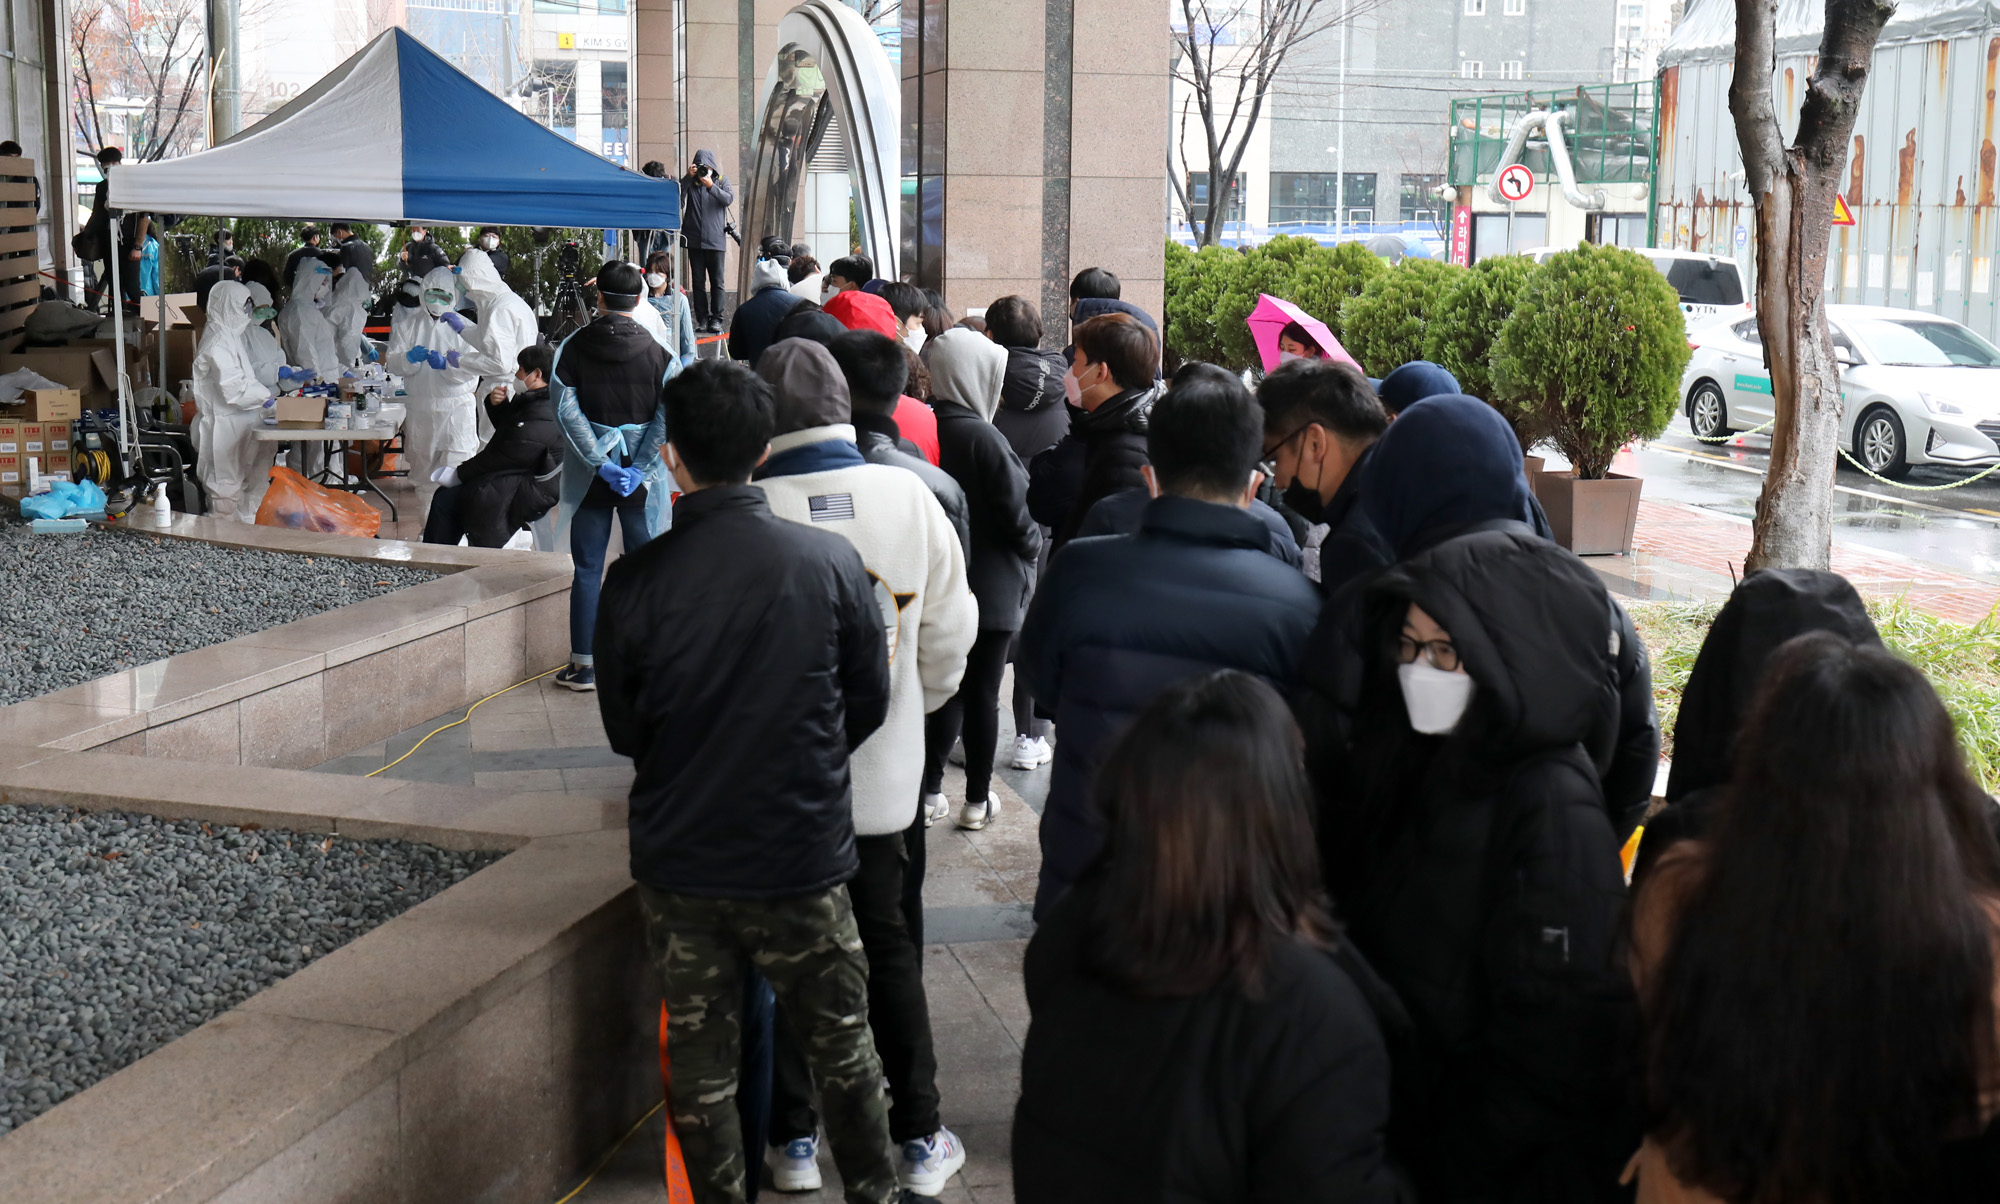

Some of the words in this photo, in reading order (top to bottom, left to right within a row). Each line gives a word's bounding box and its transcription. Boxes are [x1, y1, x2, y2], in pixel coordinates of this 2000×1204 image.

[584, 37, 603, 47] KIM
[267, 82, 301, 98] 102
[1696, 305, 1717, 314] YTN
[1038, 371, 1046, 391] new
